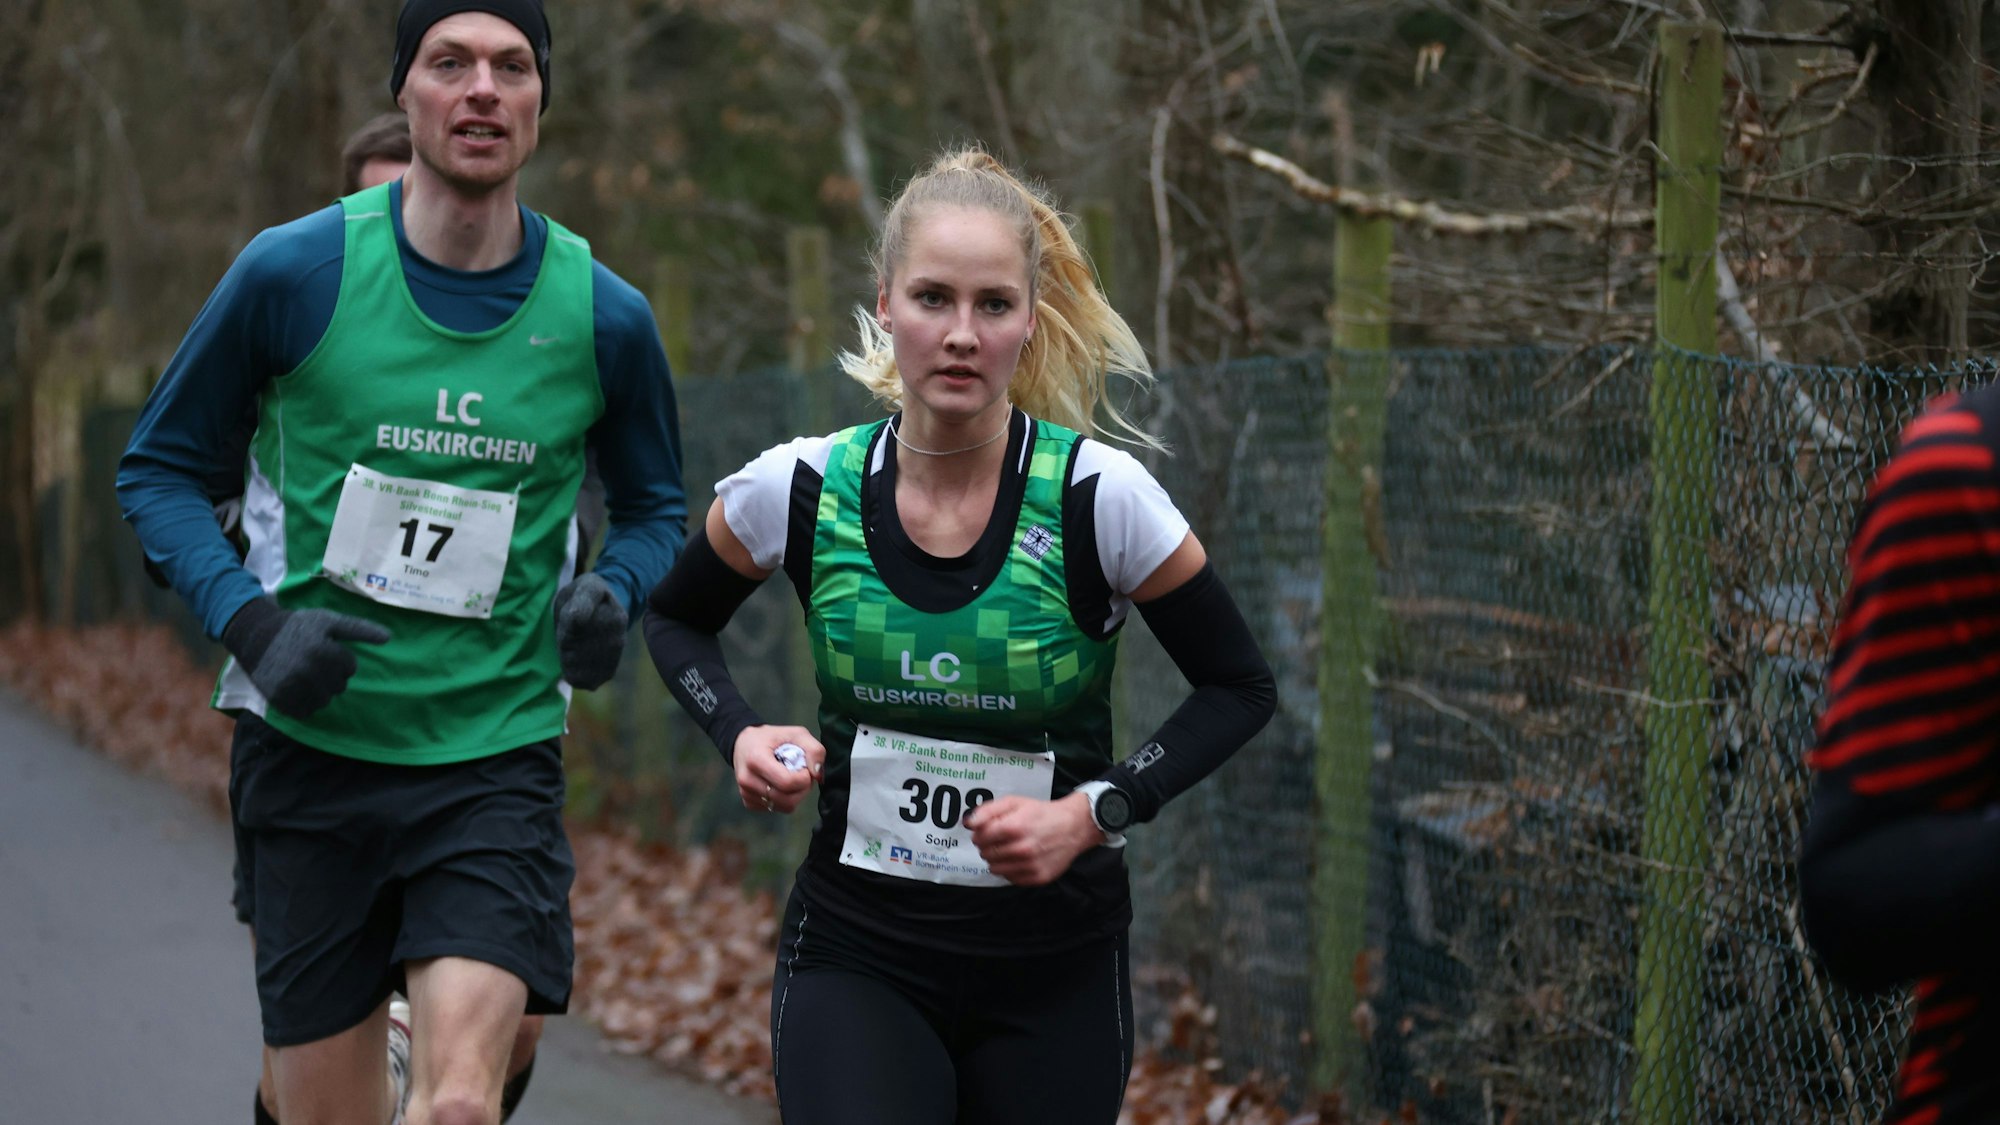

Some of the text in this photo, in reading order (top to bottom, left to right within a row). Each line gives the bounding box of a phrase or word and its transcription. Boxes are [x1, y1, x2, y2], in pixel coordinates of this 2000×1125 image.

[436, 388, 483, 426] LC
[376, 424, 537, 465] EUSKIRCHEN
[379, 481, 420, 498] VR-Bank
[422, 489, 449, 503] Bonn
[451, 495, 502, 513] Rhein-Sieg
[399, 500, 463, 521] Silvesterlauf
[399, 518, 454, 563] 17
[403, 564, 430, 578] Timo
[901, 650, 961, 683] LC
[853, 685, 1016, 711] EUSKIRCHEN
[873, 735, 1034, 770] 38. VR-Bank Bonn Rhein-Sieg
[915, 760, 986, 781] Silvesterlauf
[925, 833, 959, 849] Sonja
[916, 851, 950, 863] VR-Bank
